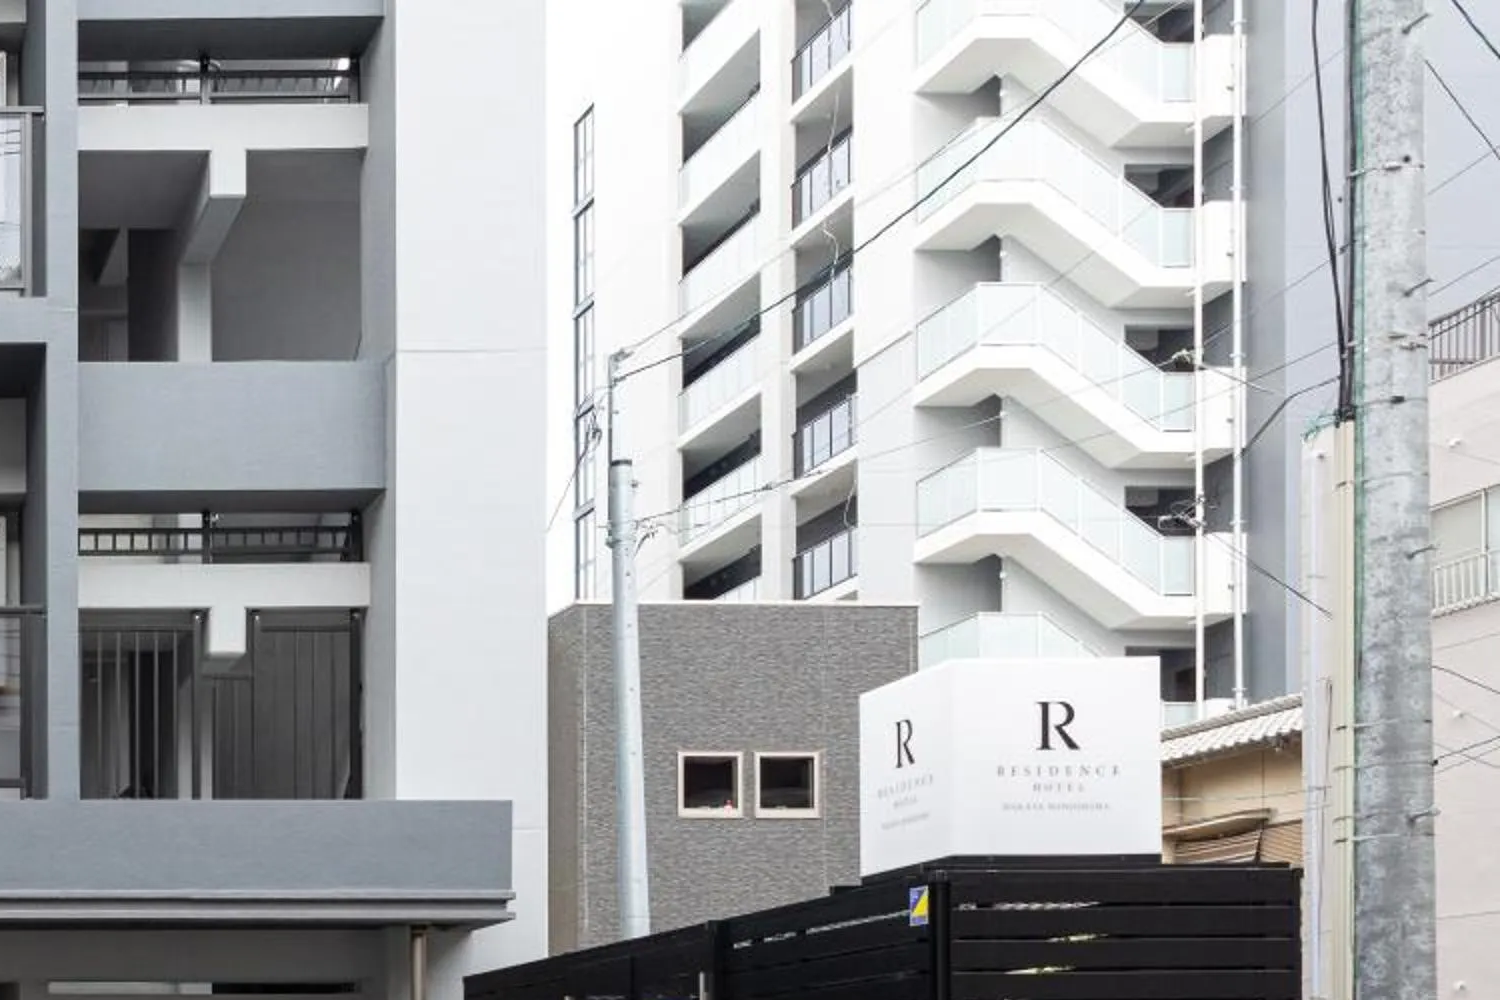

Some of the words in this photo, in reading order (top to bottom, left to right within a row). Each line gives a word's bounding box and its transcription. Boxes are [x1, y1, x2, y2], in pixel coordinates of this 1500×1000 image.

[895, 719, 915, 769] R
[1035, 701, 1081, 751] R
[996, 764, 1120, 778] RESIDENCE
